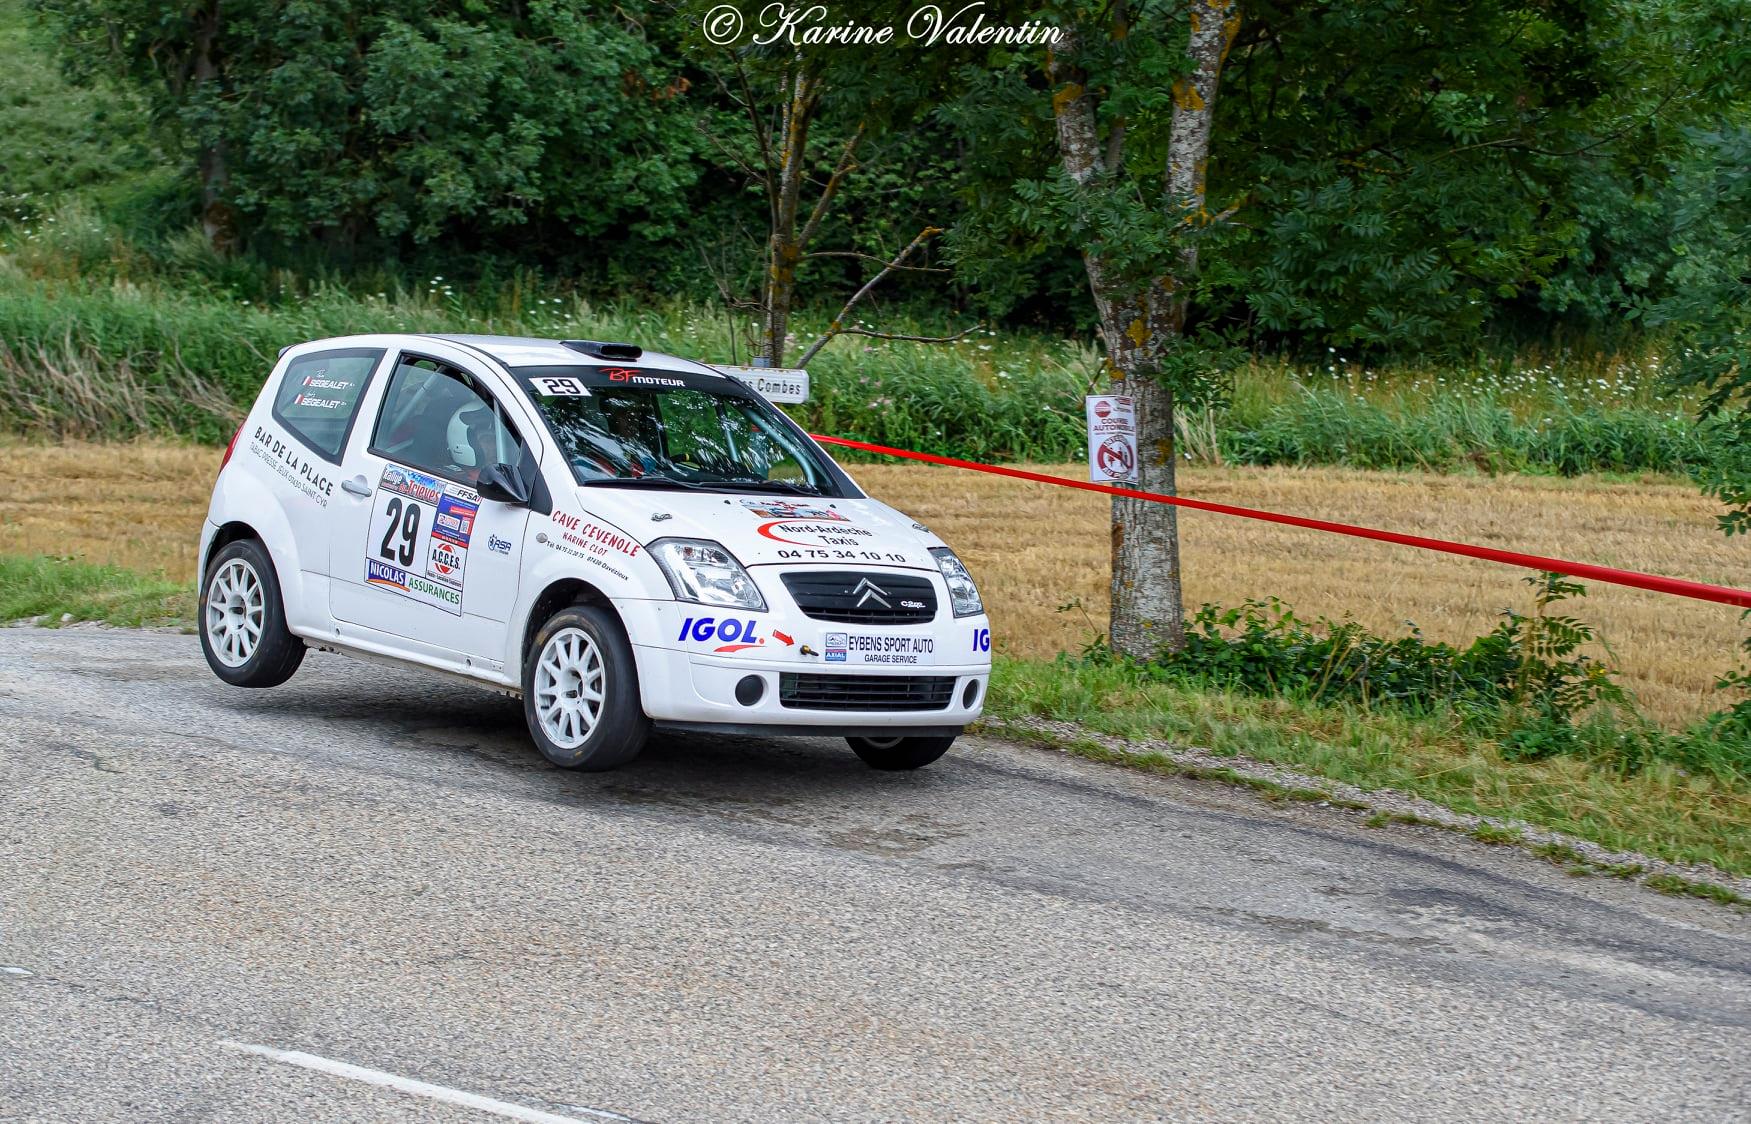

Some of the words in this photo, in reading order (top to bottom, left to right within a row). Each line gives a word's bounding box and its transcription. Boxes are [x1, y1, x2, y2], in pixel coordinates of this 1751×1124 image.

[542, 378, 581, 395] 29
[632, 376, 685, 387] MOTEUR
[757, 378, 801, 395] Combes
[254, 426, 273, 448] BAR
[272, 440, 287, 459] DE
[285, 451, 299, 471] LA
[300, 462, 334, 497] PLACE
[314, 493, 329, 508] CYR
[380, 497, 421, 567] 29
[552, 510, 581, 531] CAVE
[582, 523, 640, 557] CEVENOLE
[818, 535, 859, 546] Taxis
[589, 543, 609, 557] CLOT
[777, 549, 802, 559] 04
[804, 549, 829, 558] 75
[832, 550, 855, 559] 34
[860, 551, 881, 561] 10
[885, 552, 906, 563] 10
[370, 561, 405, 585] NICOLAS
[408, 577, 461, 605] ASSURANCES
[849, 635, 882, 652] EYBENS
[884, 636, 911, 653] SPORT
[913, 638, 934, 654] AUTO
[864, 654, 891, 663] GARAGE
[892, 655, 918, 664] SERVICE
